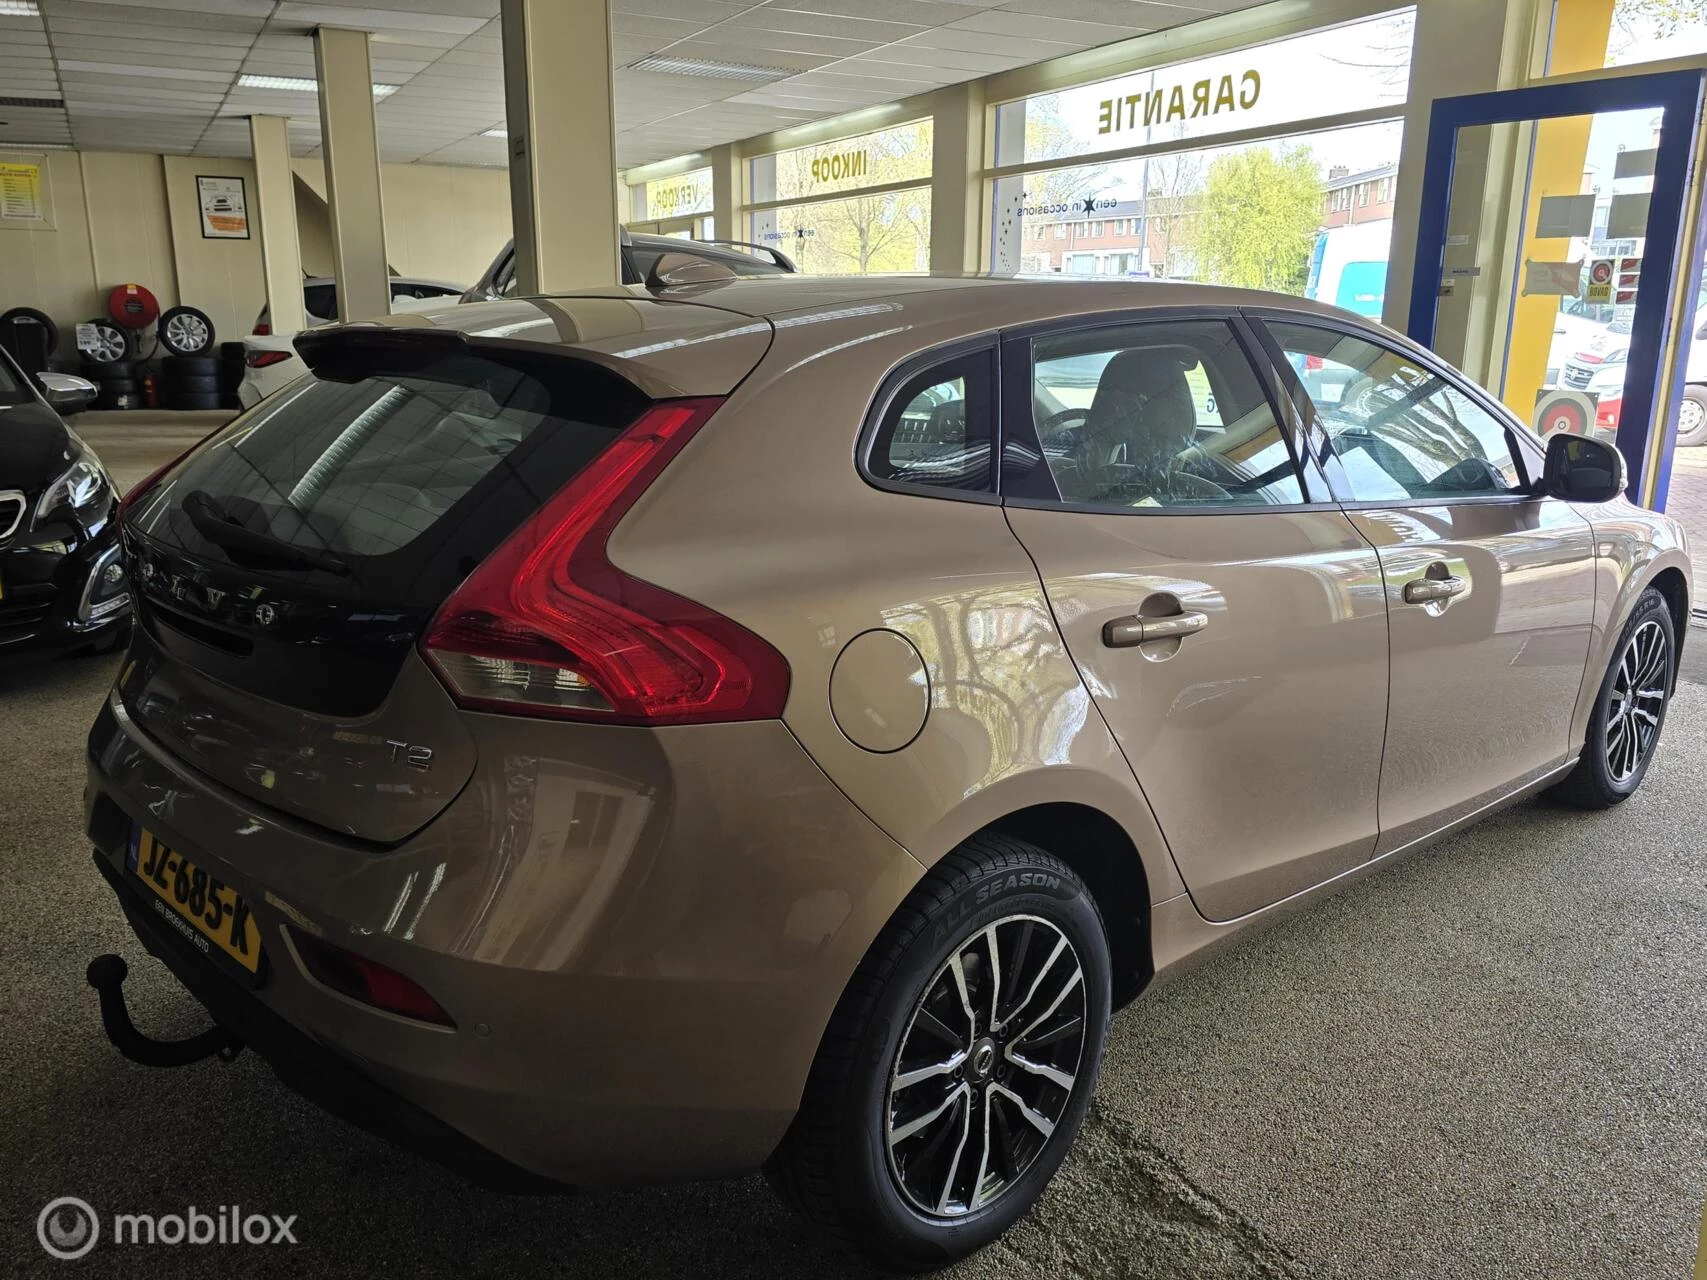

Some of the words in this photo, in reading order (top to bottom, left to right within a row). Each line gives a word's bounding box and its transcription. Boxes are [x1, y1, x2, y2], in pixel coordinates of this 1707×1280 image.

[1589, 286, 1609, 297] BOVAG
[385, 739, 433, 773] T2
[143, 836, 250, 956] JZ-685-K
[933, 900, 973, 947] ALL
[975, 872, 1061, 905] SEASON
[194, 934, 210, 953] AUTO
